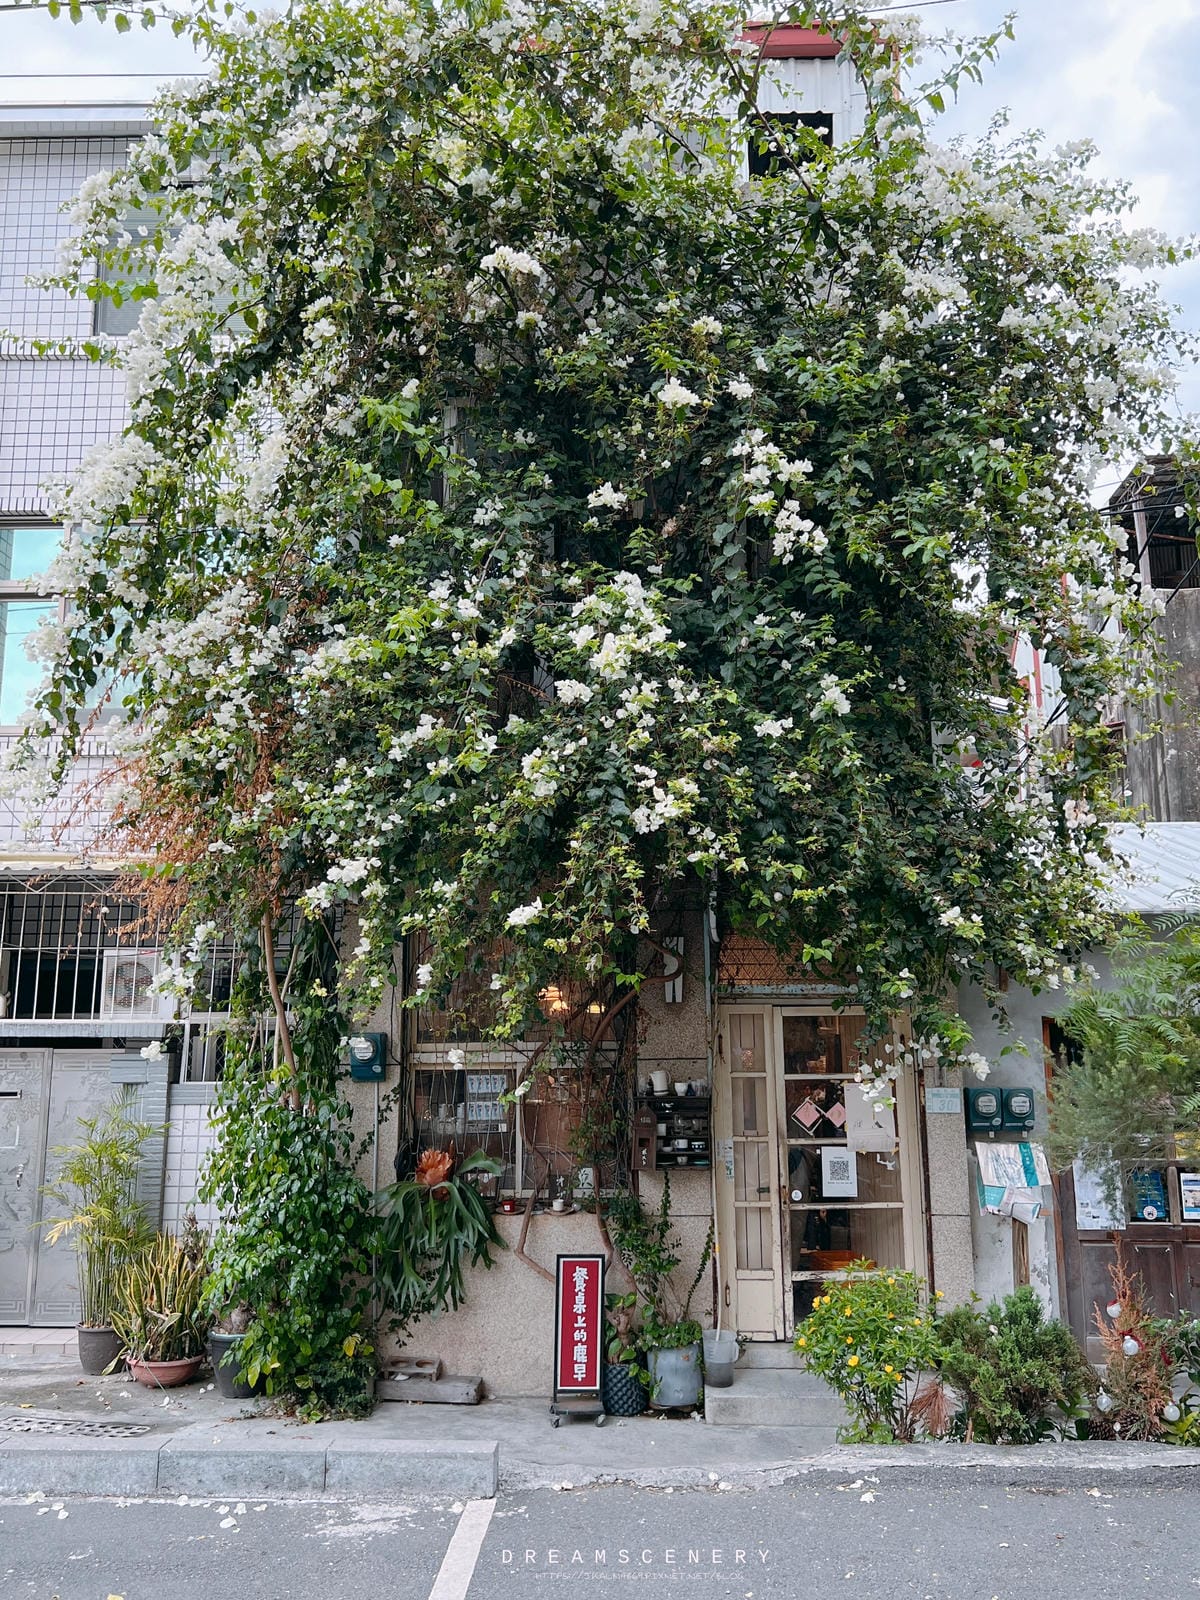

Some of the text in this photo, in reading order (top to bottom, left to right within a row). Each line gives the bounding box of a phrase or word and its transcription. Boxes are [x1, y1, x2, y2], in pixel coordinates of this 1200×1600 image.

[573, 1266, 589, 1381] 餐桌上的鹿早
